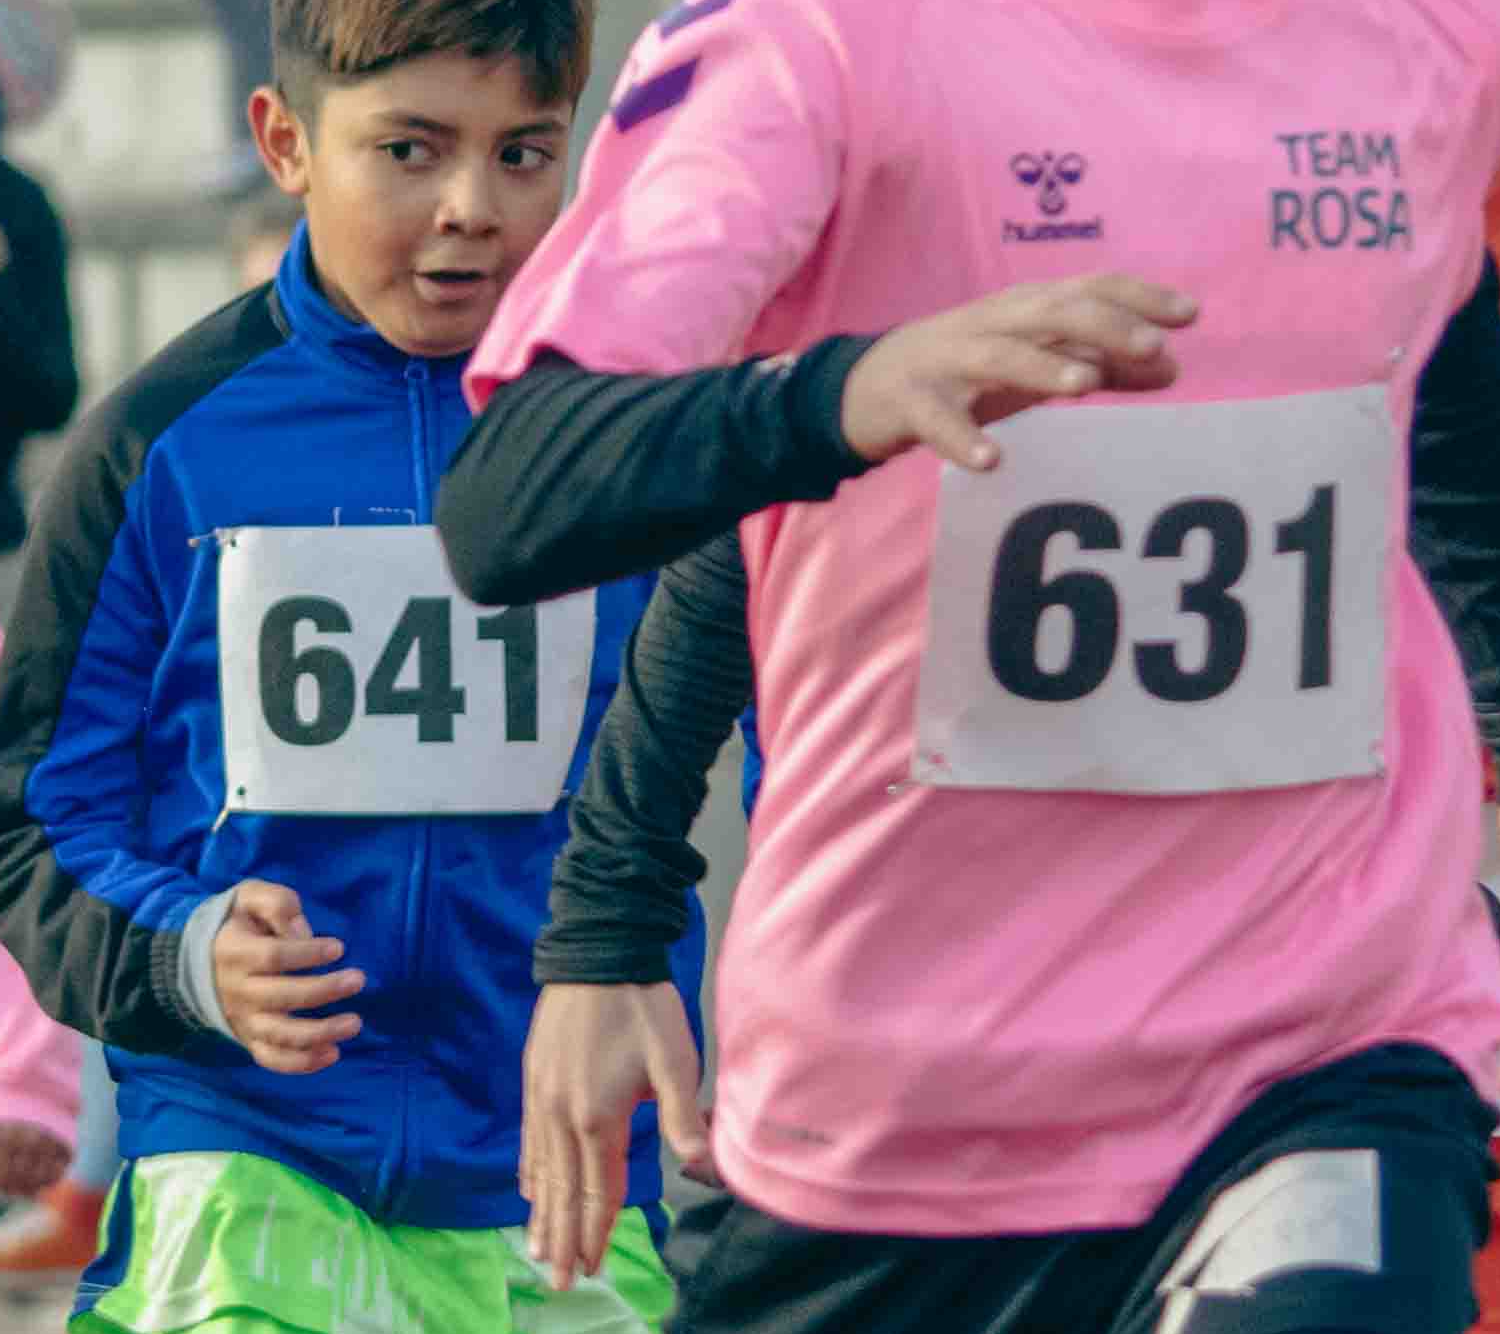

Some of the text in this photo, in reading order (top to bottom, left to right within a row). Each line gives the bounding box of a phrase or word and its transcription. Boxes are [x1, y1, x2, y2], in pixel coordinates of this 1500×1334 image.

[1275, 131, 1400, 178] TEAM
[1270, 187, 1413, 251] ROSA
[985, 483, 1336, 704] 631
[257, 595, 540, 748] 641
